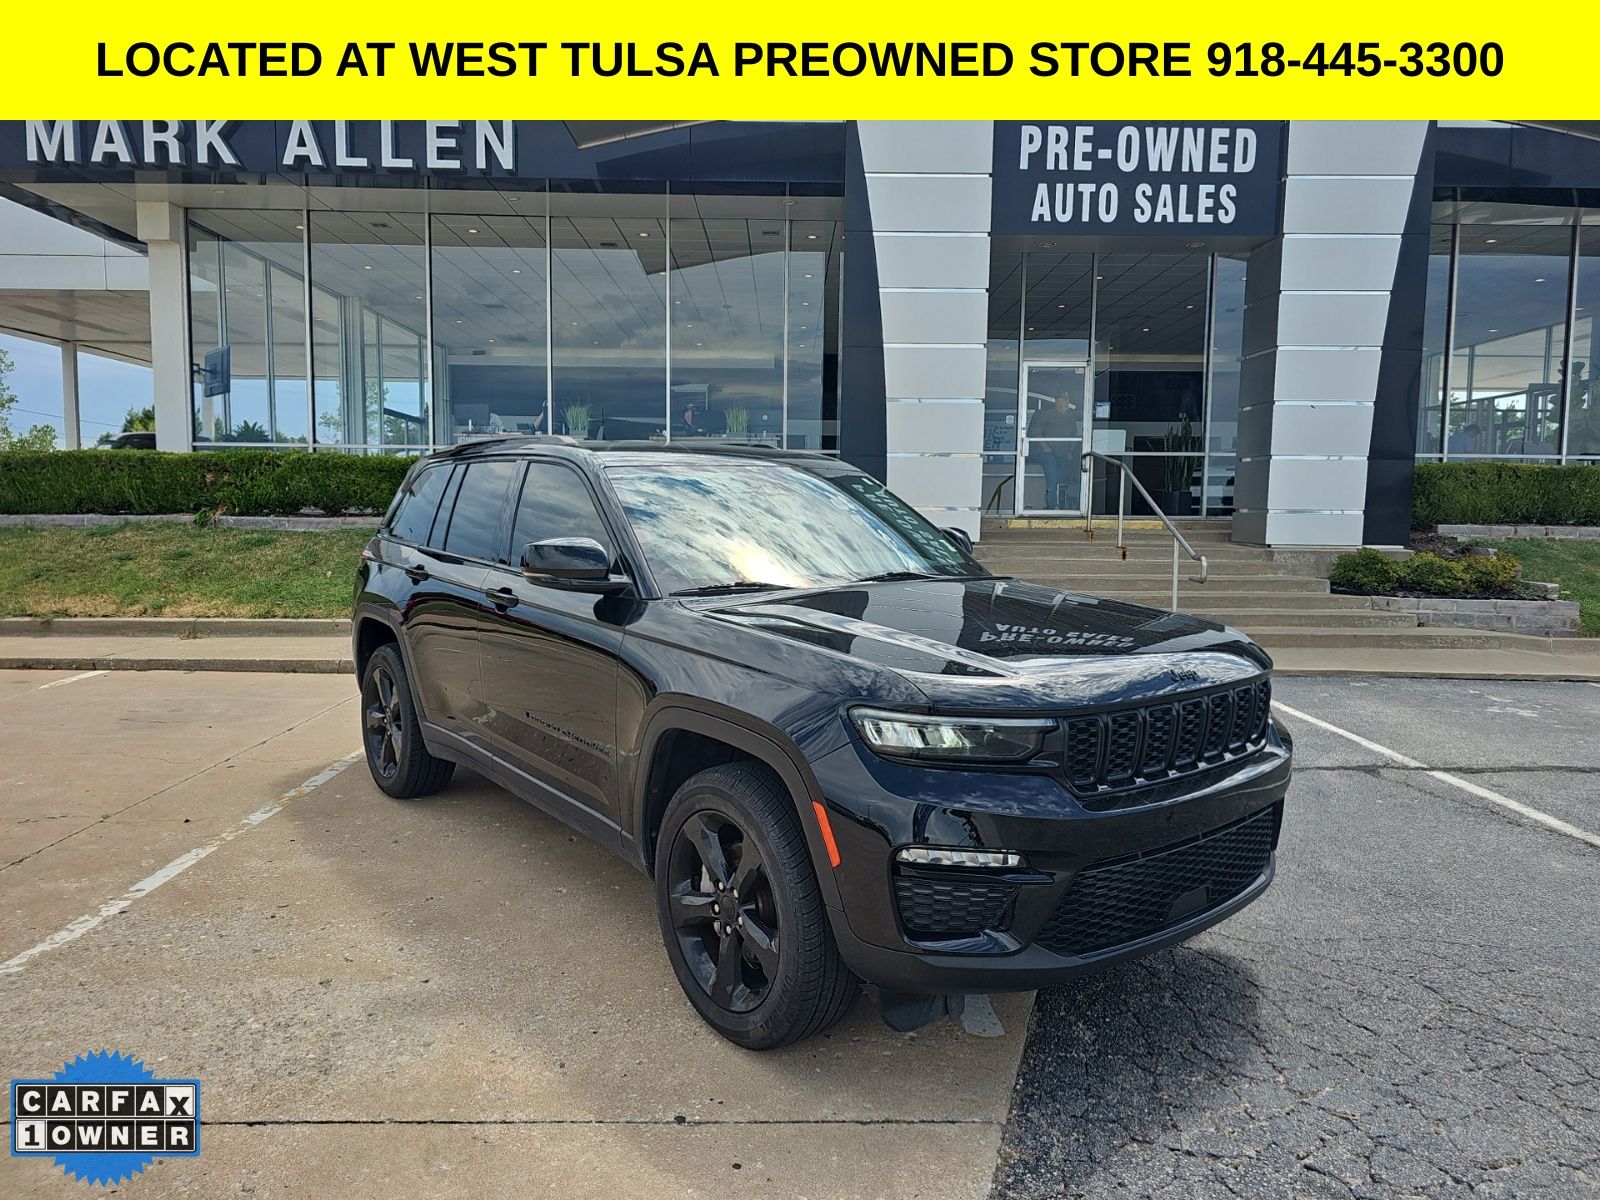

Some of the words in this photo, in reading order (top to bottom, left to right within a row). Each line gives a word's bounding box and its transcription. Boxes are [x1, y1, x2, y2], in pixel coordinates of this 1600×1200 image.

[25, 119, 239, 164] MARK
[282, 119, 514, 170] ALLEN
[1019, 125, 1257, 173] PRE-OWNED
[1031, 182, 1119, 223] AUTO
[1133, 183, 1237, 224] SALES
